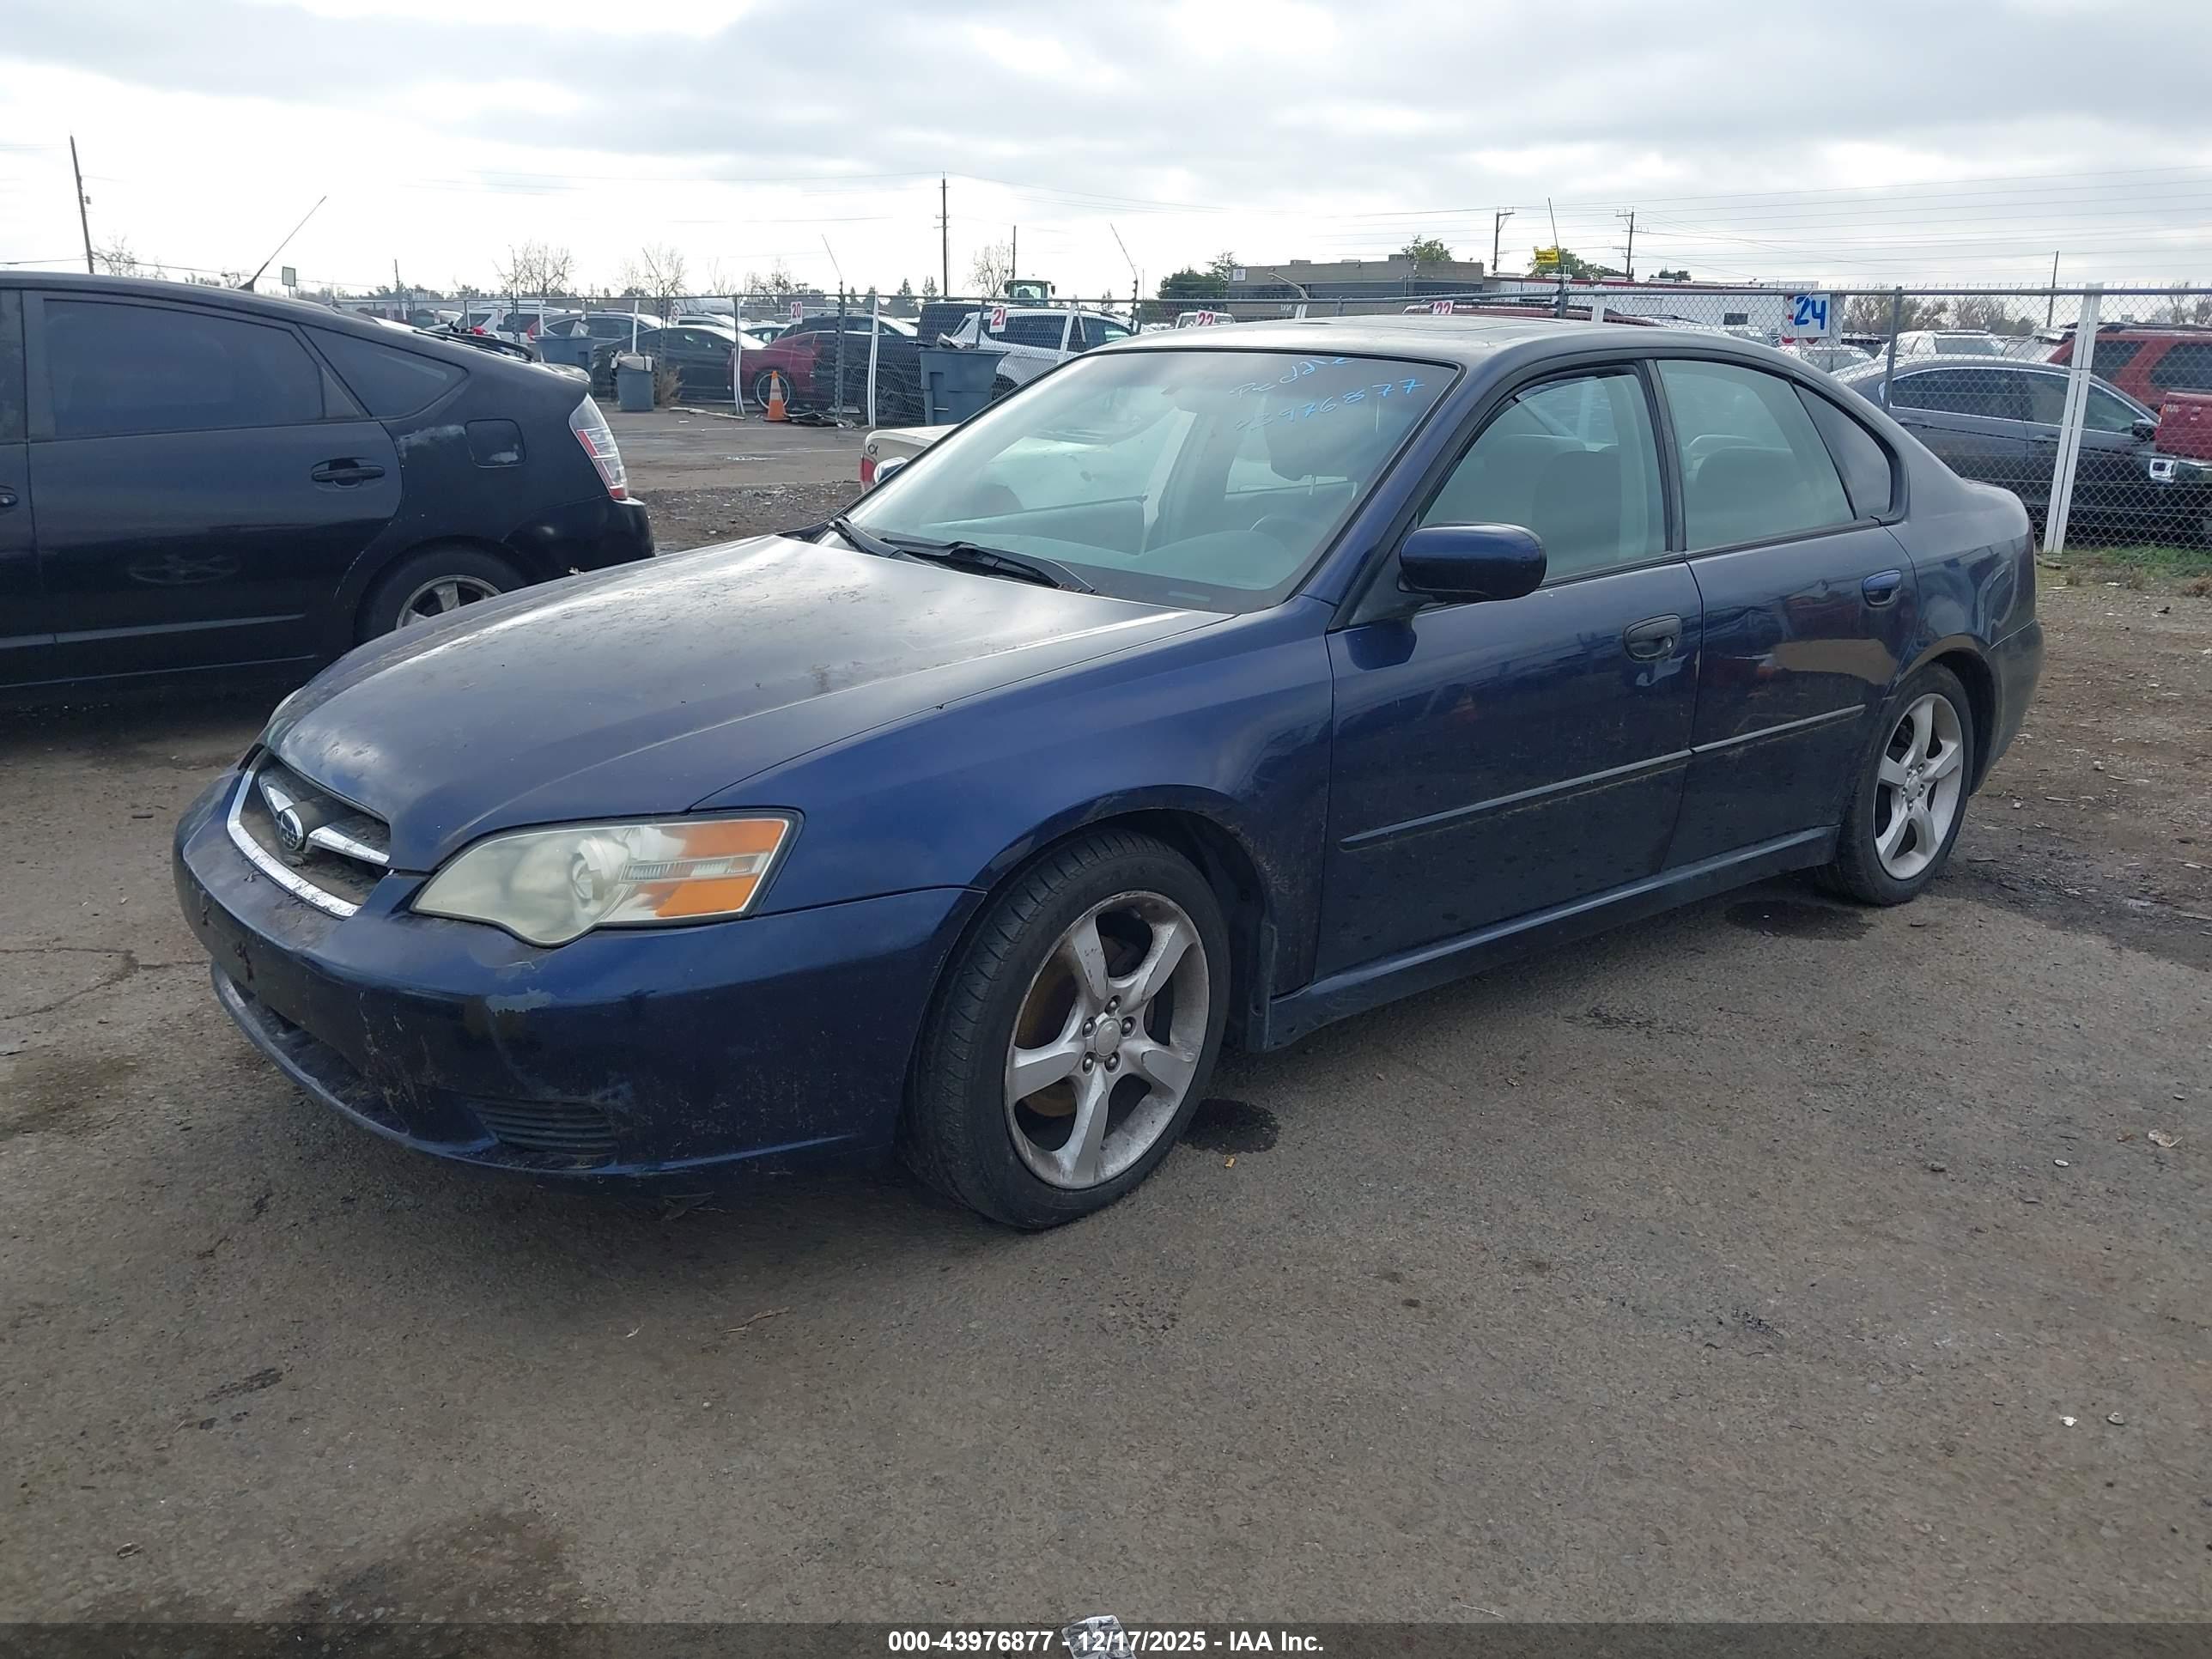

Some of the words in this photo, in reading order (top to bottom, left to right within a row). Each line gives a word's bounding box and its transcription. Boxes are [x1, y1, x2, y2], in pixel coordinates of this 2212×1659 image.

[791, 302, 802, 319] 20
[991, 308, 1006, 326] 21
[1794, 295, 1826, 331] 24
